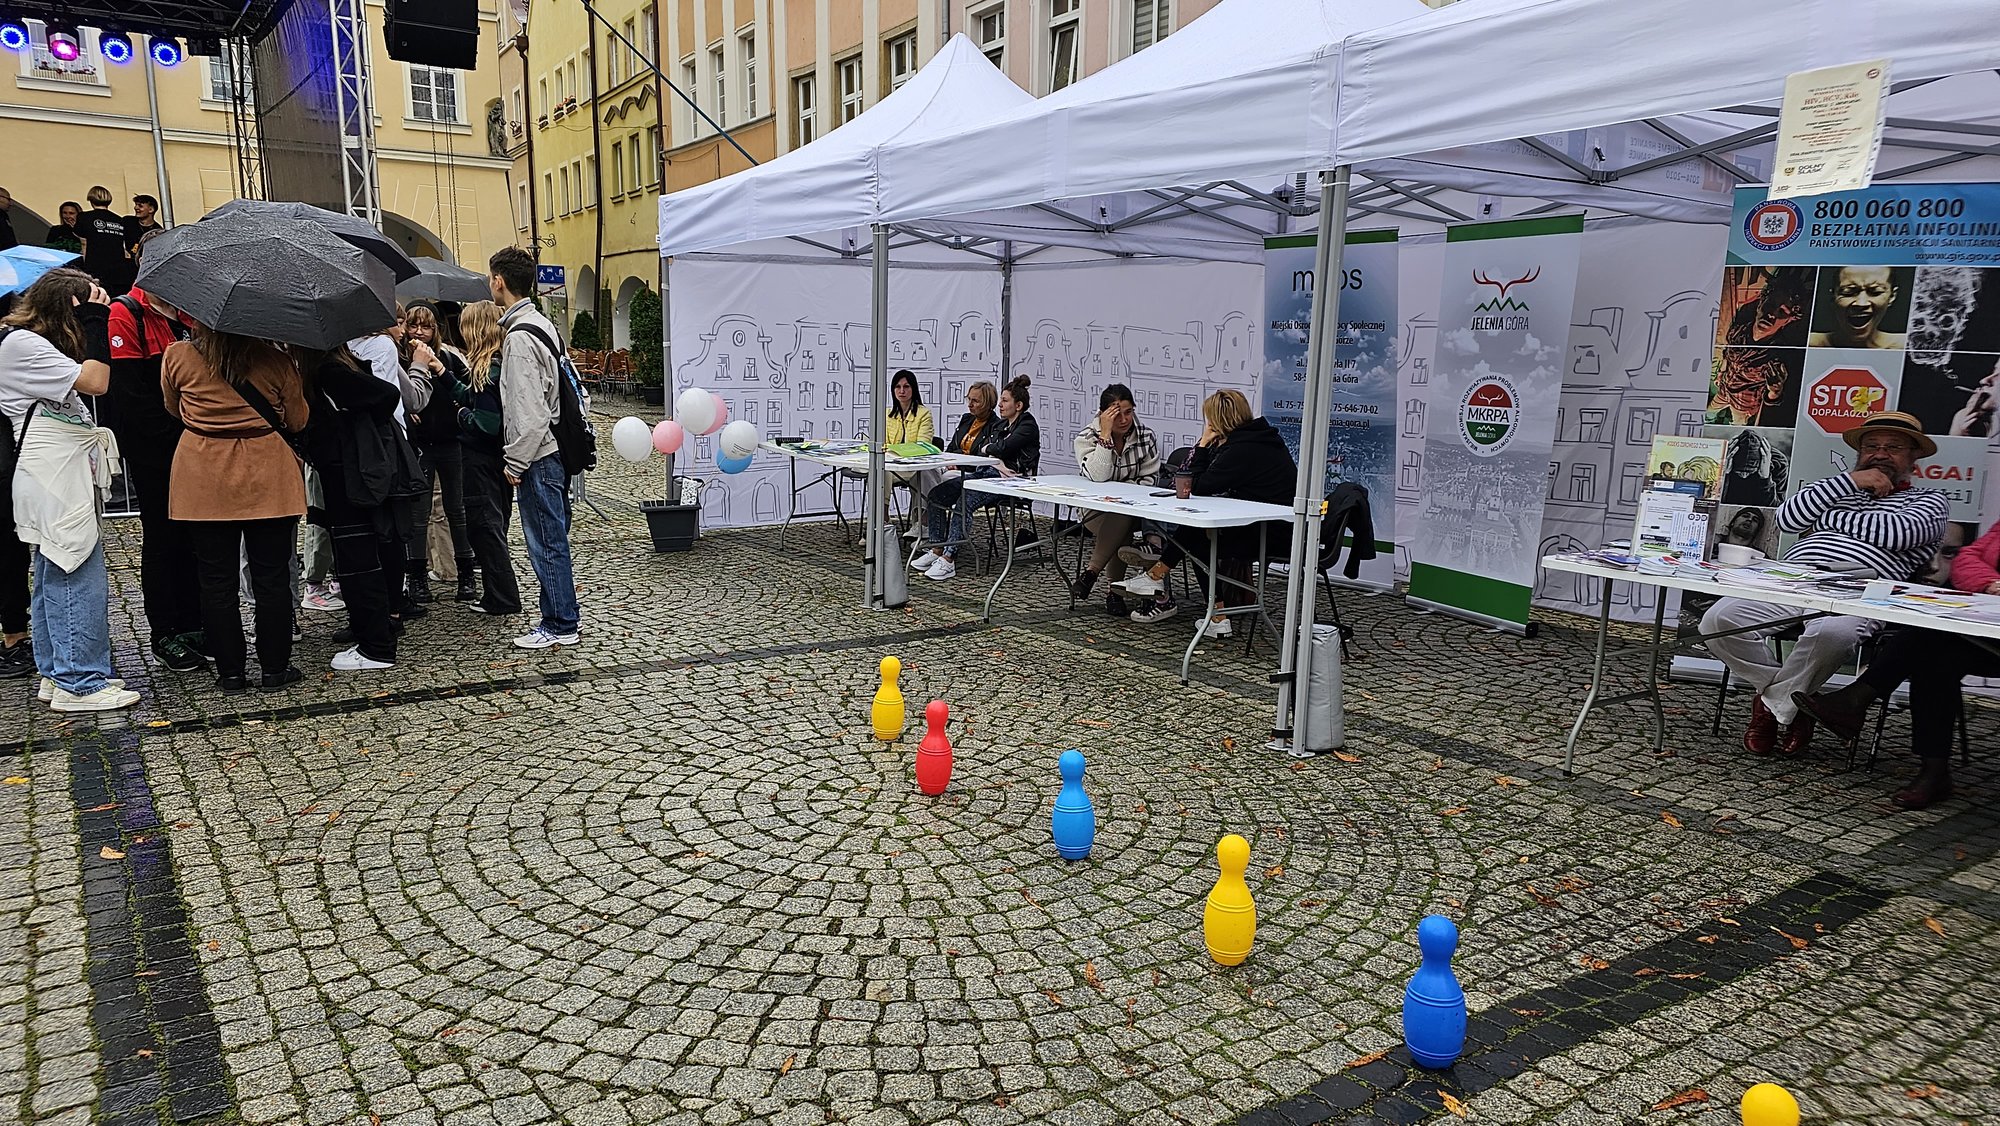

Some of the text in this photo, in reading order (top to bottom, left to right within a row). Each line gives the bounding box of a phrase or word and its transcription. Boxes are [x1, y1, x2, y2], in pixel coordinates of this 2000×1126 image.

[1813, 198, 1965, 219] 800 060 800
[1811, 222, 2000, 237] BEZPŁATNA INFOLINI
[1809, 237, 2000, 248] PAŃSTWOWEJ INSPEKCJI SANITARNE
[1292, 268, 1363, 292] ms
[1271, 320, 1293, 332] Miejski
[1294, 320, 1311, 330] Ośro
[1349, 320, 1386, 332] Społecznej
[1471, 315, 1529, 331] JELENIA GÓRA
[1342, 373, 1359, 384] Góra
[1273, 400, 1284, 409] tel.
[1467, 407, 1510, 423] MKRPA
[1811, 408, 1877, 418] DOPALACZO
[1912, 463, 1975, 481] AGA!
